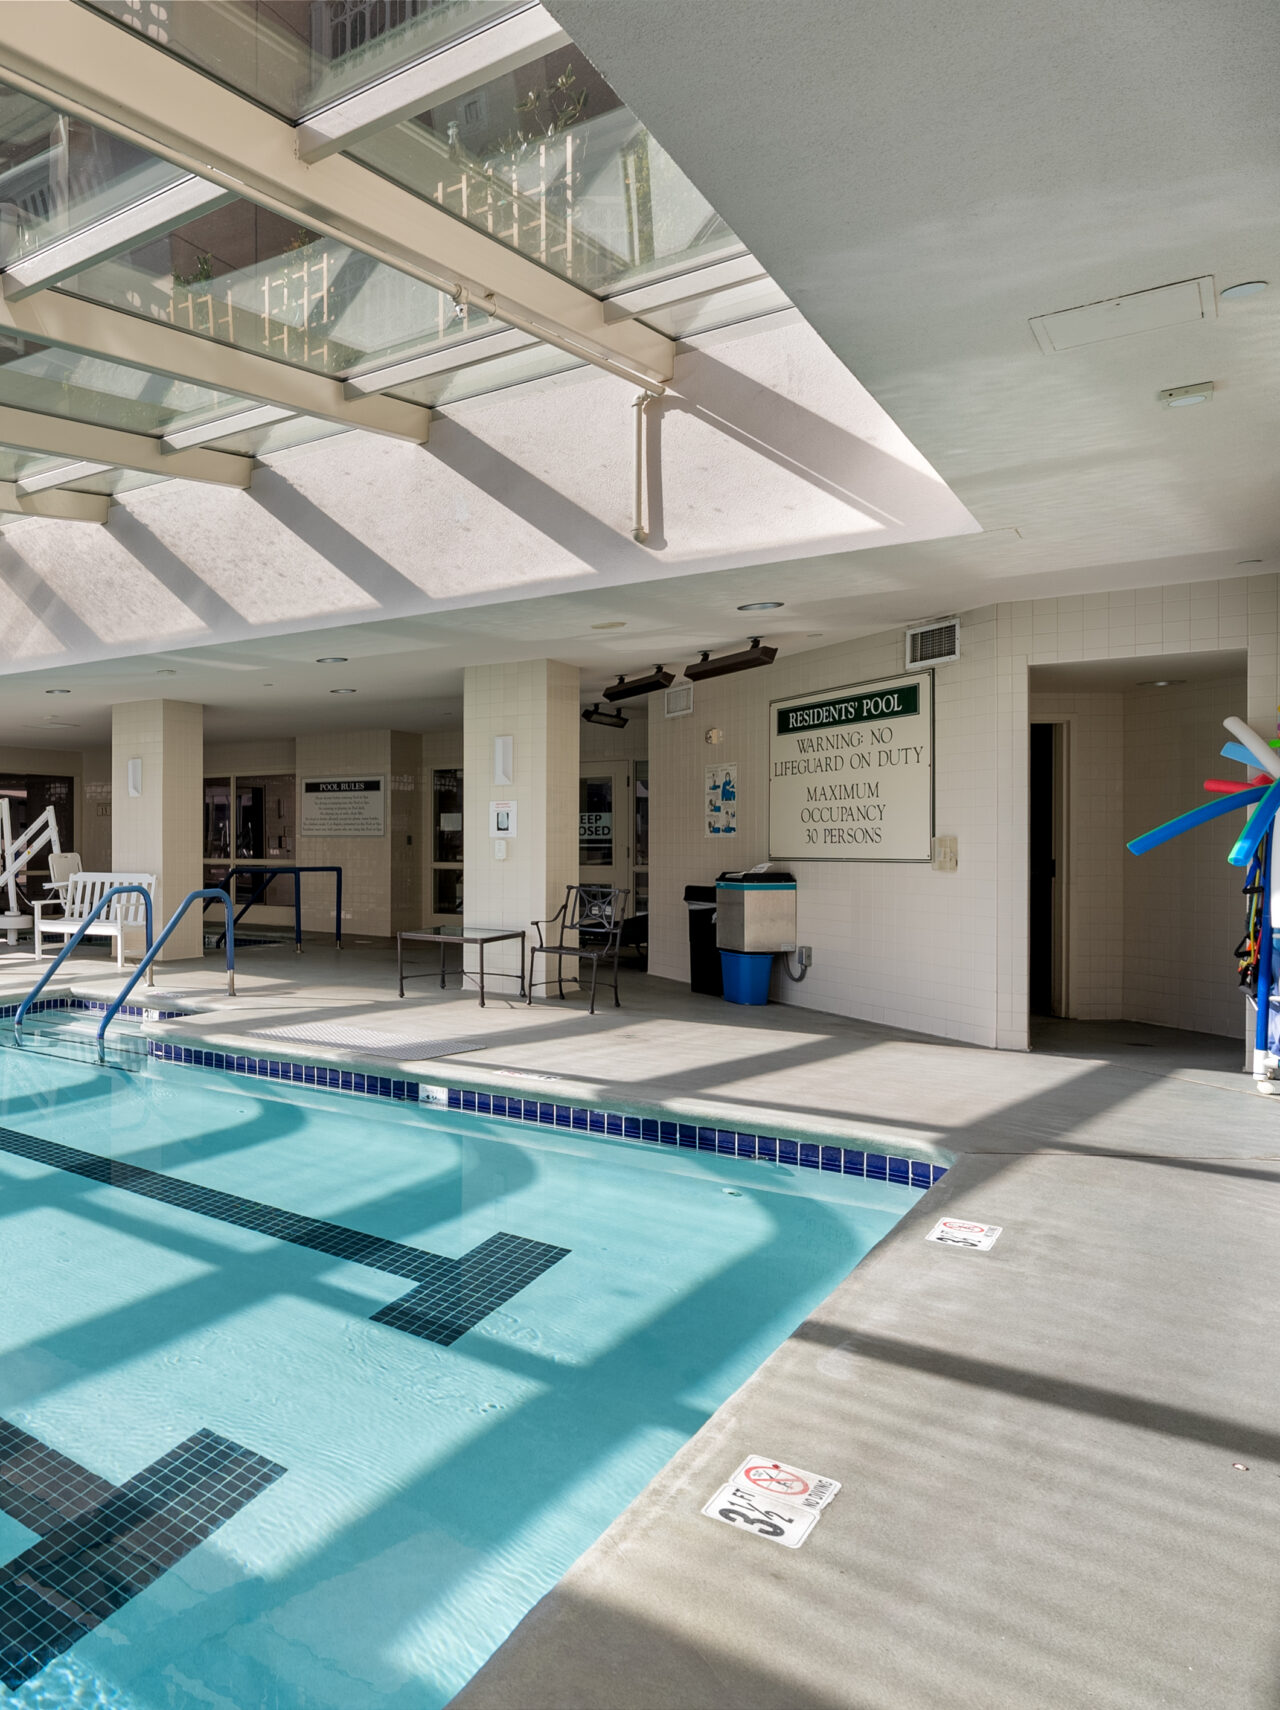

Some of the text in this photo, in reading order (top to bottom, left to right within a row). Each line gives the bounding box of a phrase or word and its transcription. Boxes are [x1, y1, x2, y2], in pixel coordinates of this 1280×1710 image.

[788, 694, 903, 729] RESIDENTS' POOL
[796, 726, 893, 754] WARNING: NO
[774, 746, 924, 777] LIFEGUARD ON DUTY
[319, 782, 365, 791] POOL RULES
[806, 781, 880, 802] MAXIMUM
[580, 814, 602, 825] EEP
[800, 804, 886, 823] OCCUPANCY
[579, 825, 611, 836] OSED
[805, 827, 882, 844] 30 PERSONS
[801, 1480, 833, 1510] NO DIVING
